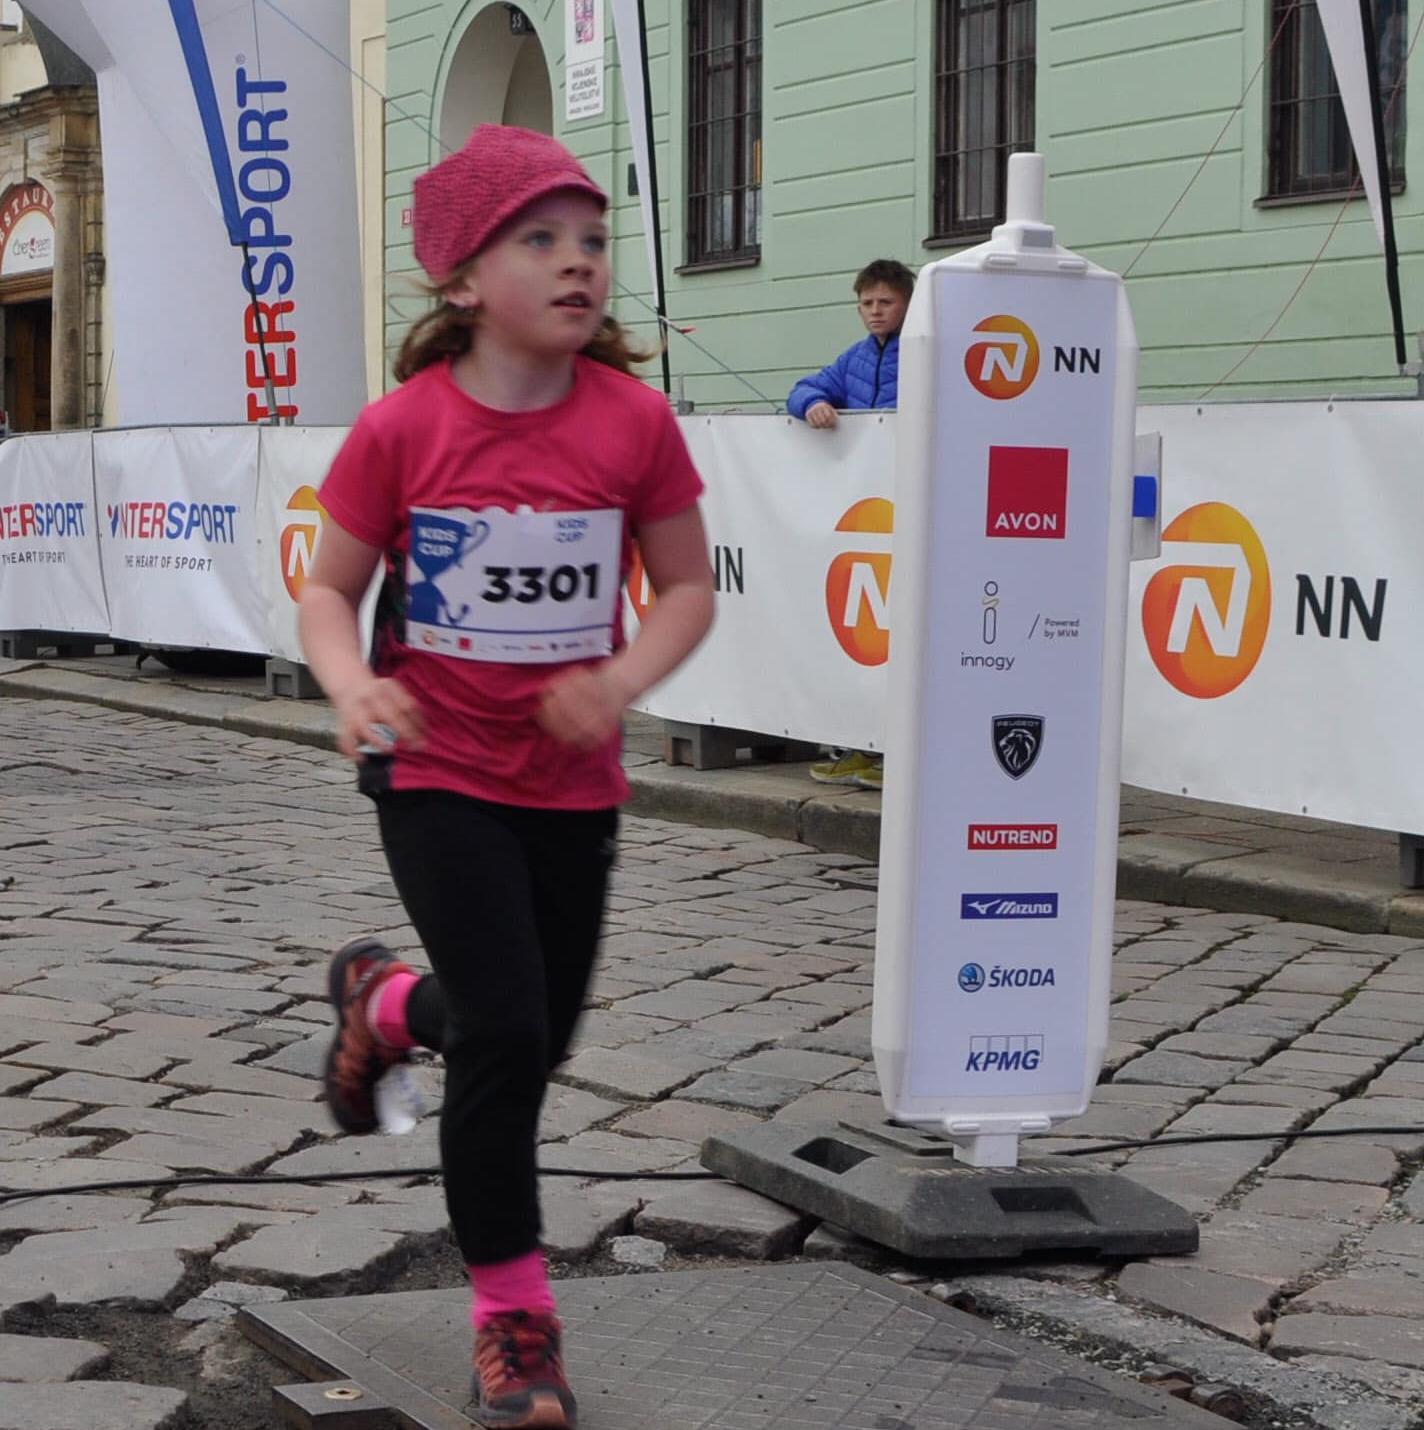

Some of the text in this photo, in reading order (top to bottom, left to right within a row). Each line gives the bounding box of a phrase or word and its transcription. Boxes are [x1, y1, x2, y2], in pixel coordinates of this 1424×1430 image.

[235, 66, 299, 422] TERSPORT
[1053, 346, 1101, 374] NN
[119, 501, 236, 544] NTERSPORT
[994, 512, 1057, 531] AVON
[160, 555, 172, 569] OF
[174, 556, 213, 572] SPORT
[481, 562, 600, 604] 3301
[1295, 574, 1388, 643] NN
[960, 651, 1016, 672] innogy
[972, 829, 1055, 845] NUTREND
[988, 965, 1056, 988] ŠKODA
[965, 1049, 1041, 1072] KPMG
